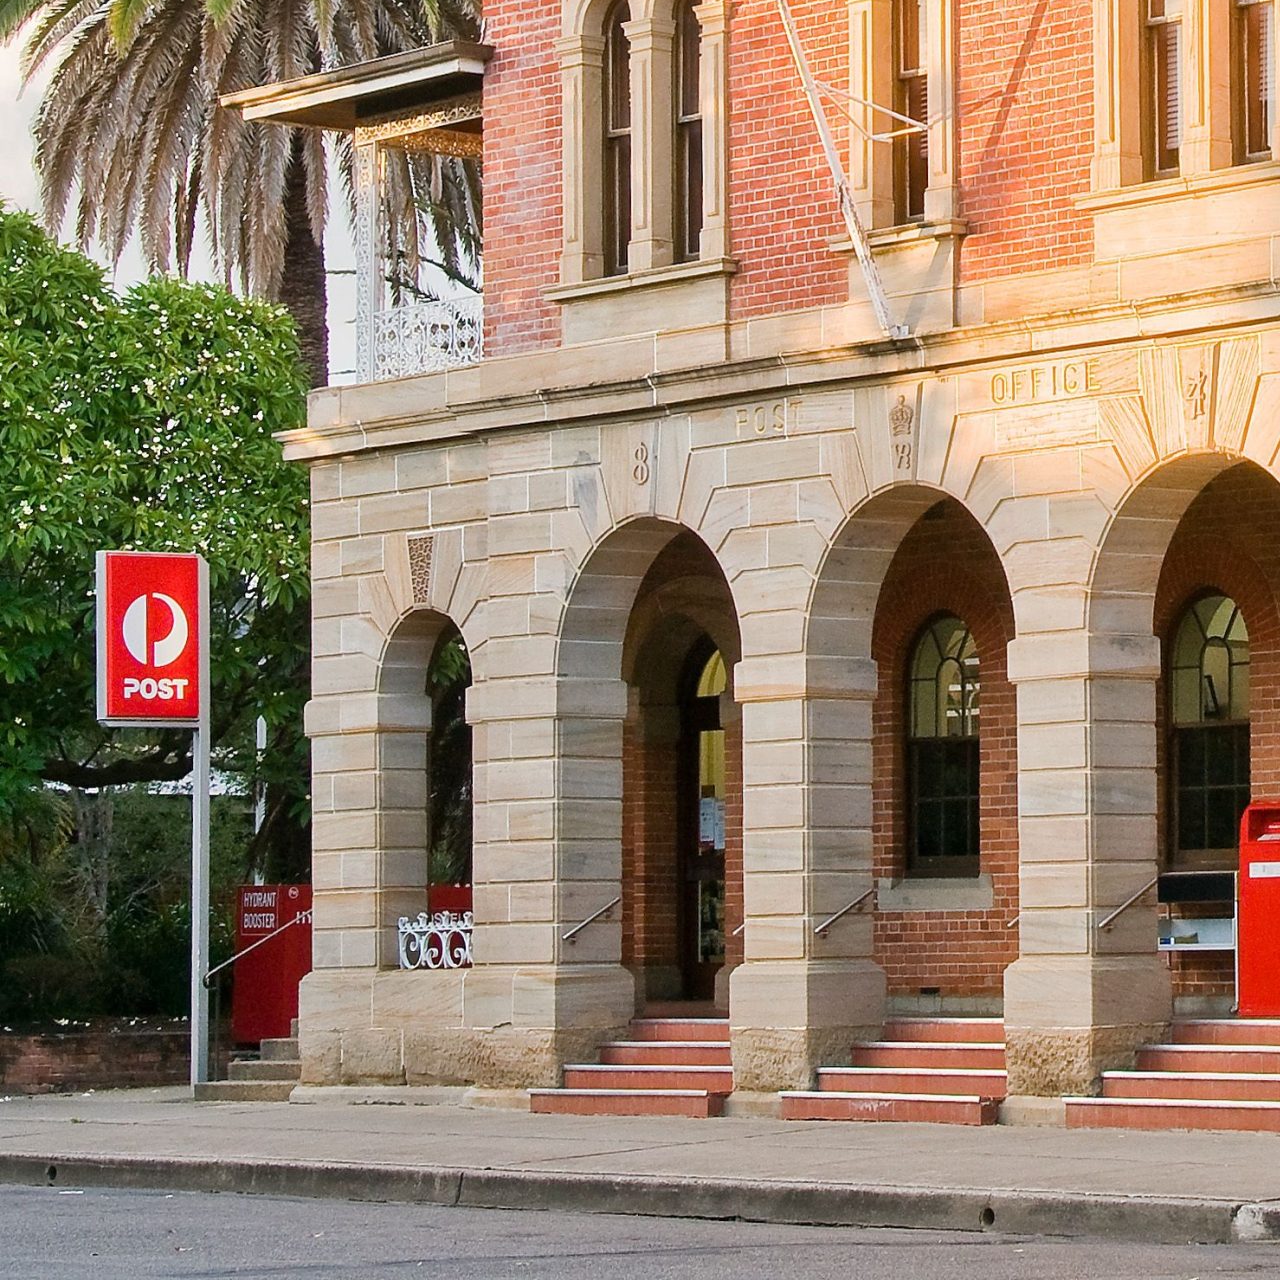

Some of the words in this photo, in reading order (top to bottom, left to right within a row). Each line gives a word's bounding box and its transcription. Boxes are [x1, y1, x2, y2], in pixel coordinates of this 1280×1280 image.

[735, 400, 803, 437] POST
[990, 357, 1101, 404] OFFICE
[123, 677, 189, 700] POST
[243, 892, 277, 908] HYDRANT
[243, 913, 276, 929] BOOSTER
